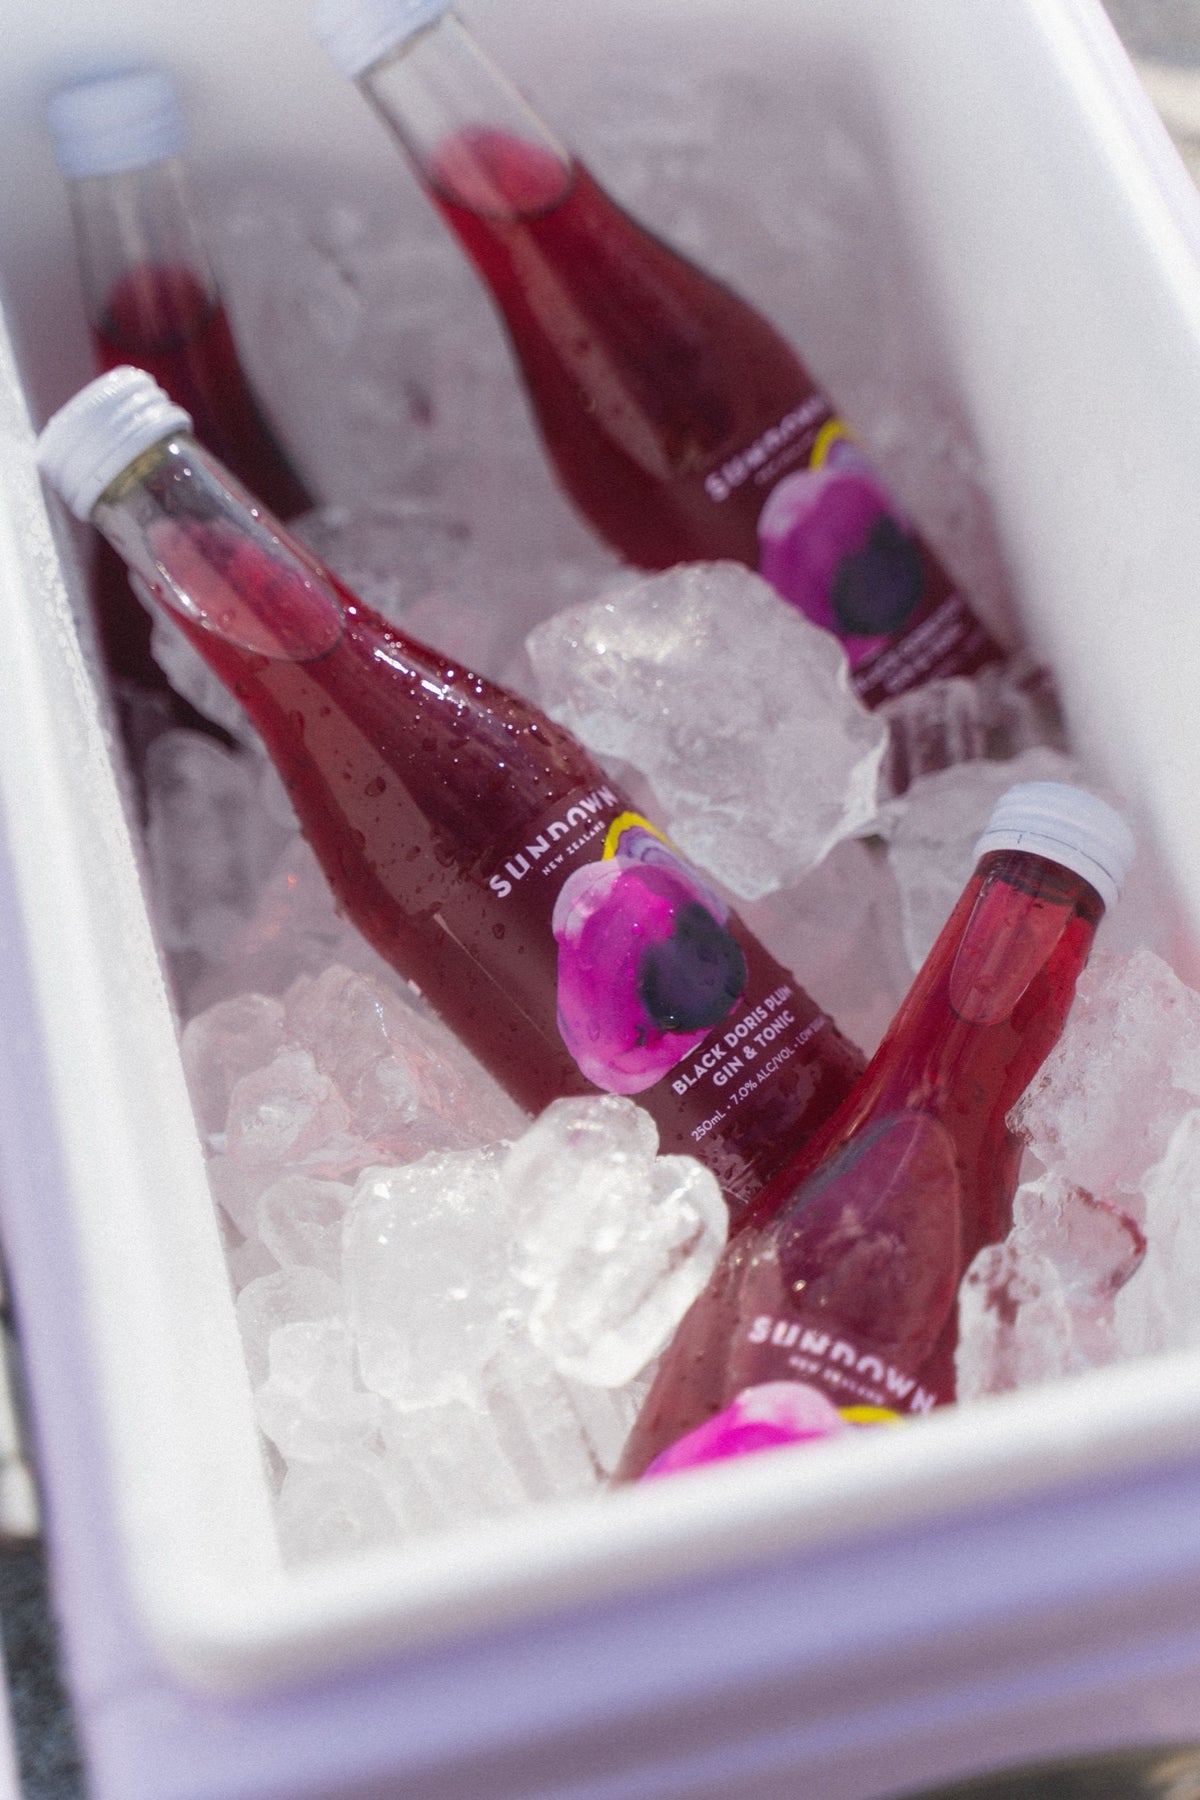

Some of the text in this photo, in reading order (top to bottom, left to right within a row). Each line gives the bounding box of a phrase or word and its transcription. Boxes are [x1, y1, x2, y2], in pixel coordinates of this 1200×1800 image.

[489, 785, 617, 898] SUNDOWN
[541, 820, 606, 876] NEW ZEALAND
[671, 1043, 727, 1095] BLACK
[723, 1006, 768, 1048] DORIS
[764, 985, 792, 1011] PLUM
[713, 1056, 744, 1086] GIN
[742, 1045, 758, 1060] &
[753, 1010, 795, 1047] TONIC
[691, 1110, 726, 1142] 250mL
[729, 1080, 758, 1105] 7.0%
[757, 1047, 795, 1083] ALC/VOL
[748, 1315, 937, 1415] SUNDOWN
